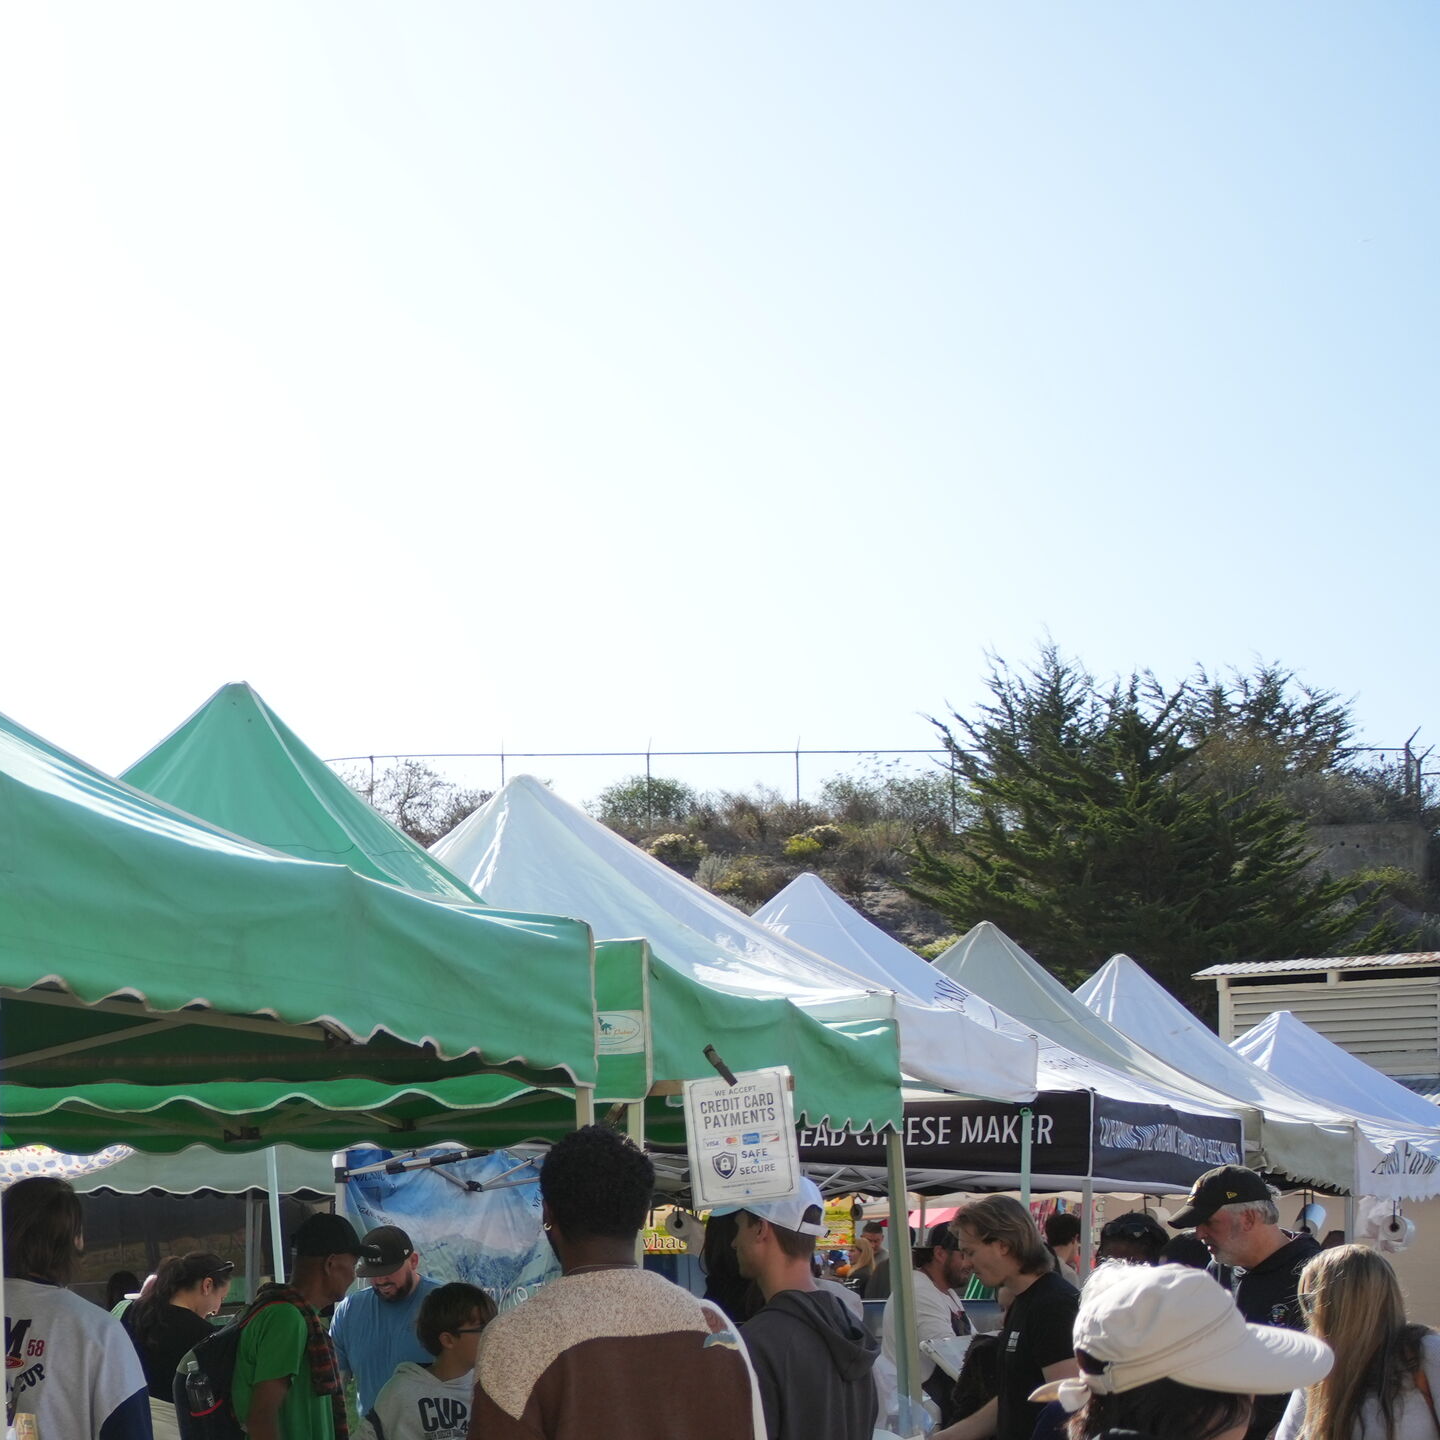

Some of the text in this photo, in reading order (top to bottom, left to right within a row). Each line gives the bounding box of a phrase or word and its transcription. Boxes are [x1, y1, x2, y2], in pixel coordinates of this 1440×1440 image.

[714, 1085, 757, 1097] WE ACCEPT
[700, 1092, 775, 1115] CREDIT CARD
[703, 1107, 776, 1130] PAYMENTS
[855, 1115, 952, 1147] CHESE
[705, 1140, 720, 1148] VISA
[741, 1148, 768, 1159] SAFE
[739, 1163, 776, 1176] SECURE
[26, 1339, 45, 1357] 58
[418, 1397, 468, 1432] CUP
